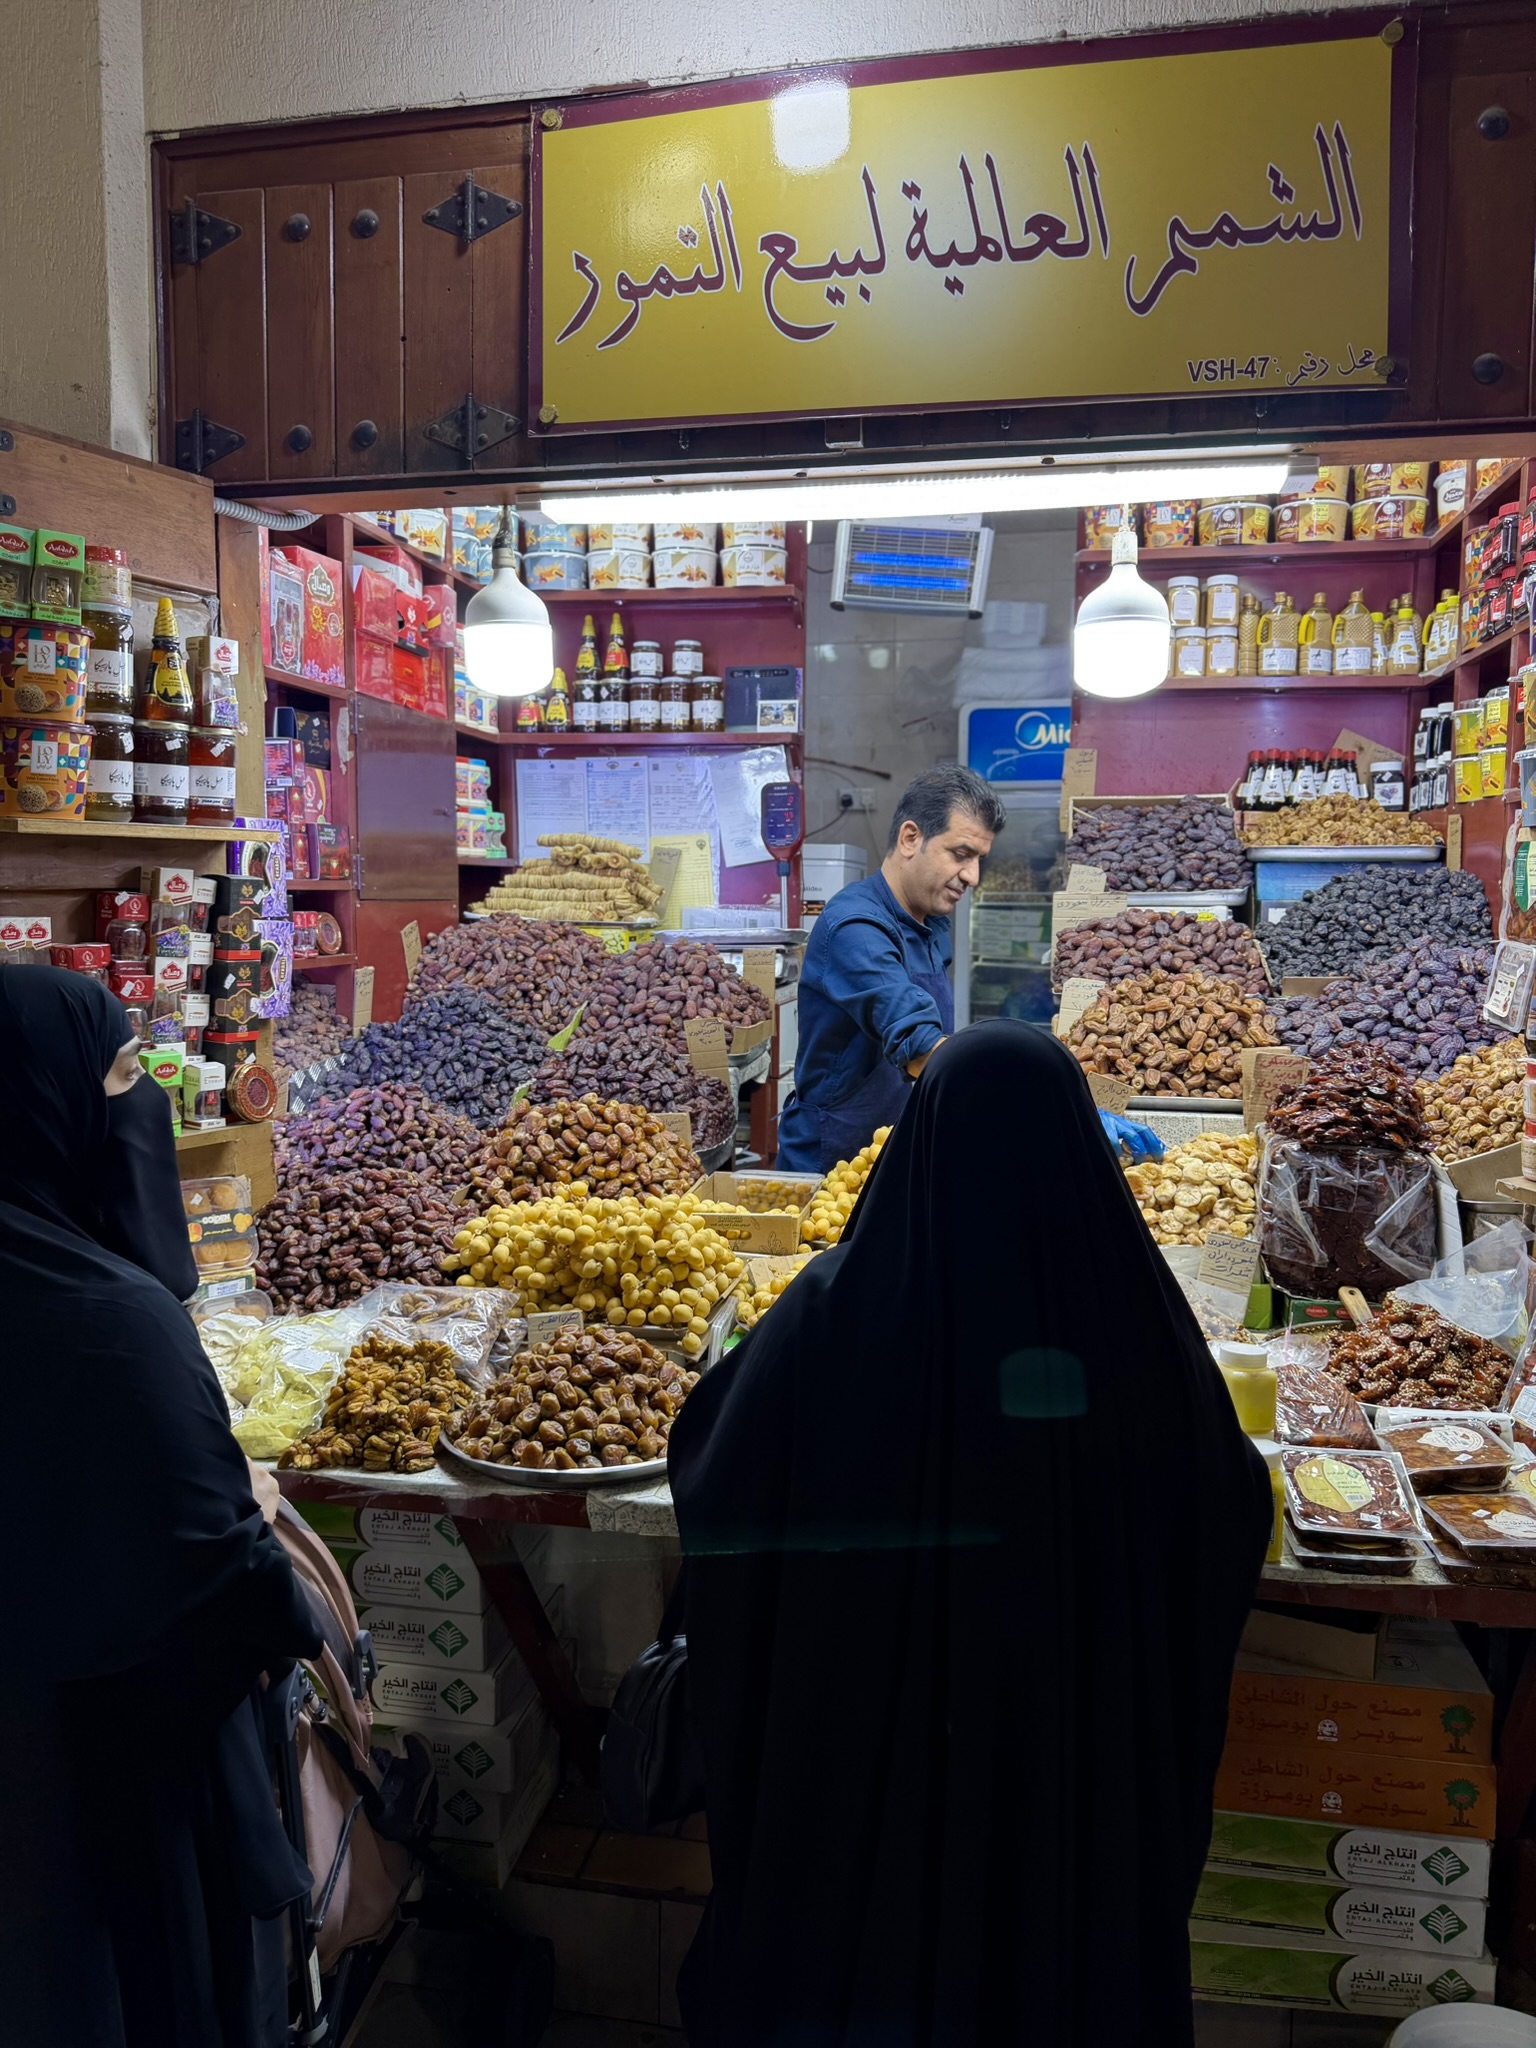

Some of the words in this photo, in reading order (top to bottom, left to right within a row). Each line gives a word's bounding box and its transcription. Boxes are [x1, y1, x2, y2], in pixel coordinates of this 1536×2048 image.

[901, 142, 1109, 297] العالمية
[759, 164, 887, 343] لبيع
[556, 180, 742, 351] التمور
[1337, 343, 1377, 376] محل
[1187, 356, 1270, 383] VSH-47
[371, 1510, 399, 1523] الخير
[397, 1622, 425, 1635] انتاج
[382, 1677, 408, 1689] الخير
[1314, 1694, 1358, 1712] حول
[1367, 1698, 1421, 1721] مصنع
[1319, 1766, 1362, 1785] حول
[1371, 1772, 1426, 1793] مصنع
[1347, 1843, 1380, 1857] الخير
[1384, 1847, 1417, 1861] انتاج
[1346, 1901, 1379, 1915] الخير
[1382, 1905, 1416, 1919] انتاج
